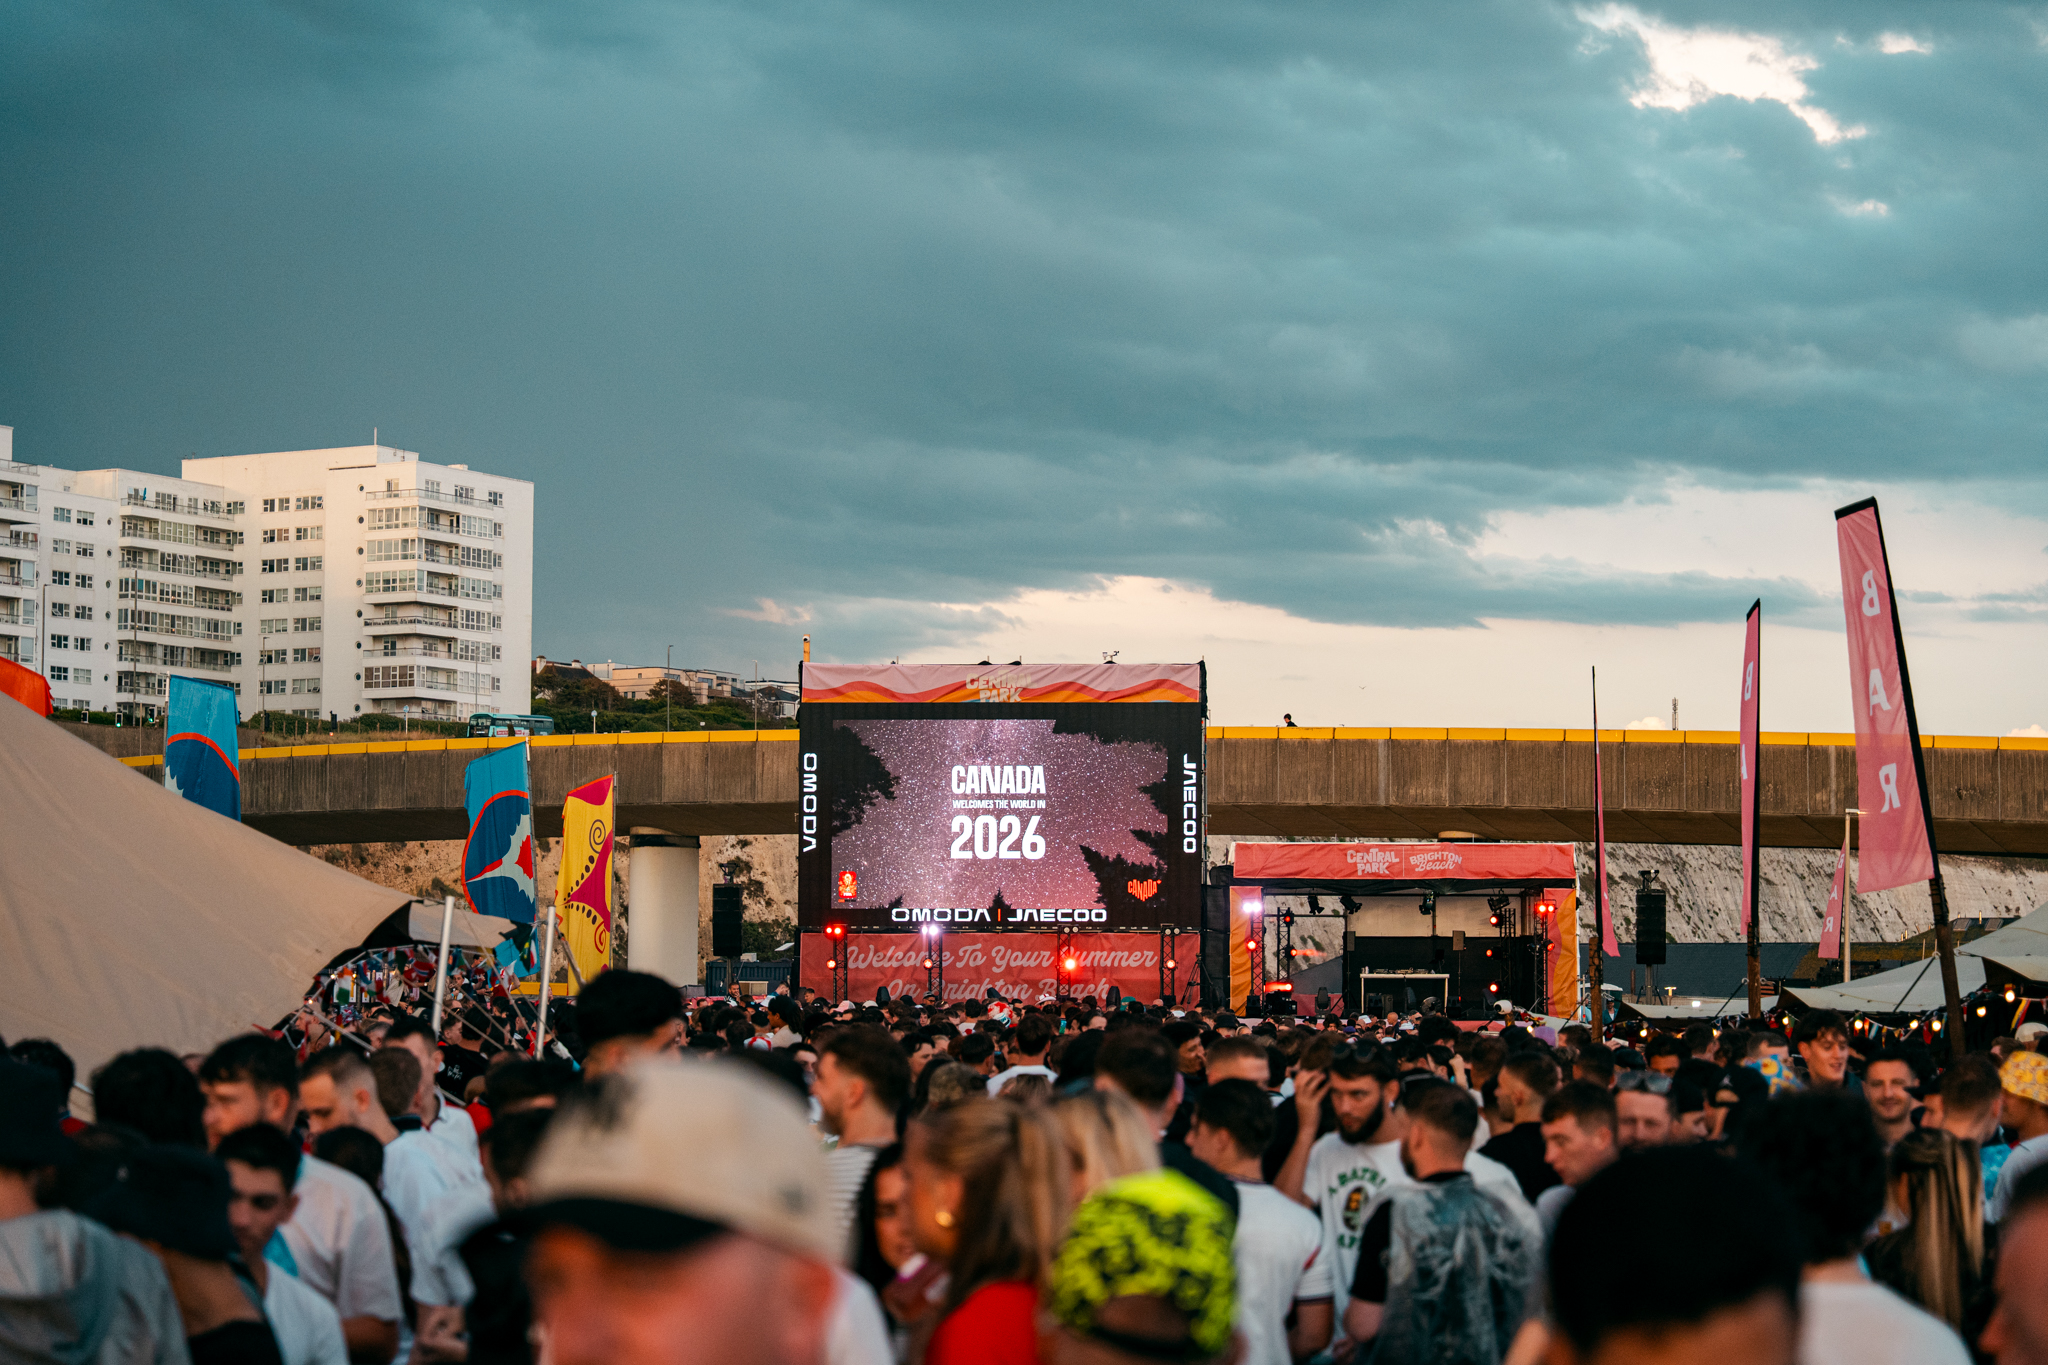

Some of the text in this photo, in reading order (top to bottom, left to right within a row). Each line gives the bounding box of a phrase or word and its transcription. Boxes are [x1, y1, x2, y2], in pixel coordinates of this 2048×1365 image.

[966, 670, 1037, 689] CENTRAL
[979, 688, 1024, 703] PARK
[951, 764, 1046, 794] CANADA
[803, 752, 817, 852] OMODA
[952, 799, 1046, 809] WELCOMES THE WORLD IN
[1183, 753, 1197, 853] JAECOO
[950, 814, 1046, 860] 2026
[1346, 848, 1399, 863] CENTRAL
[1409, 851, 1462, 865] BRIGHTON
[1357, 862, 1389, 875] PARK
[1415, 860, 1455, 872] Beach
[1127, 879, 1158, 902] CANADA
[891, 908, 1108, 922] OMODA JAECOO
[956, 943, 986, 968] To
[991, 945, 1054, 973] Your
[888, 979, 920, 1001] On
